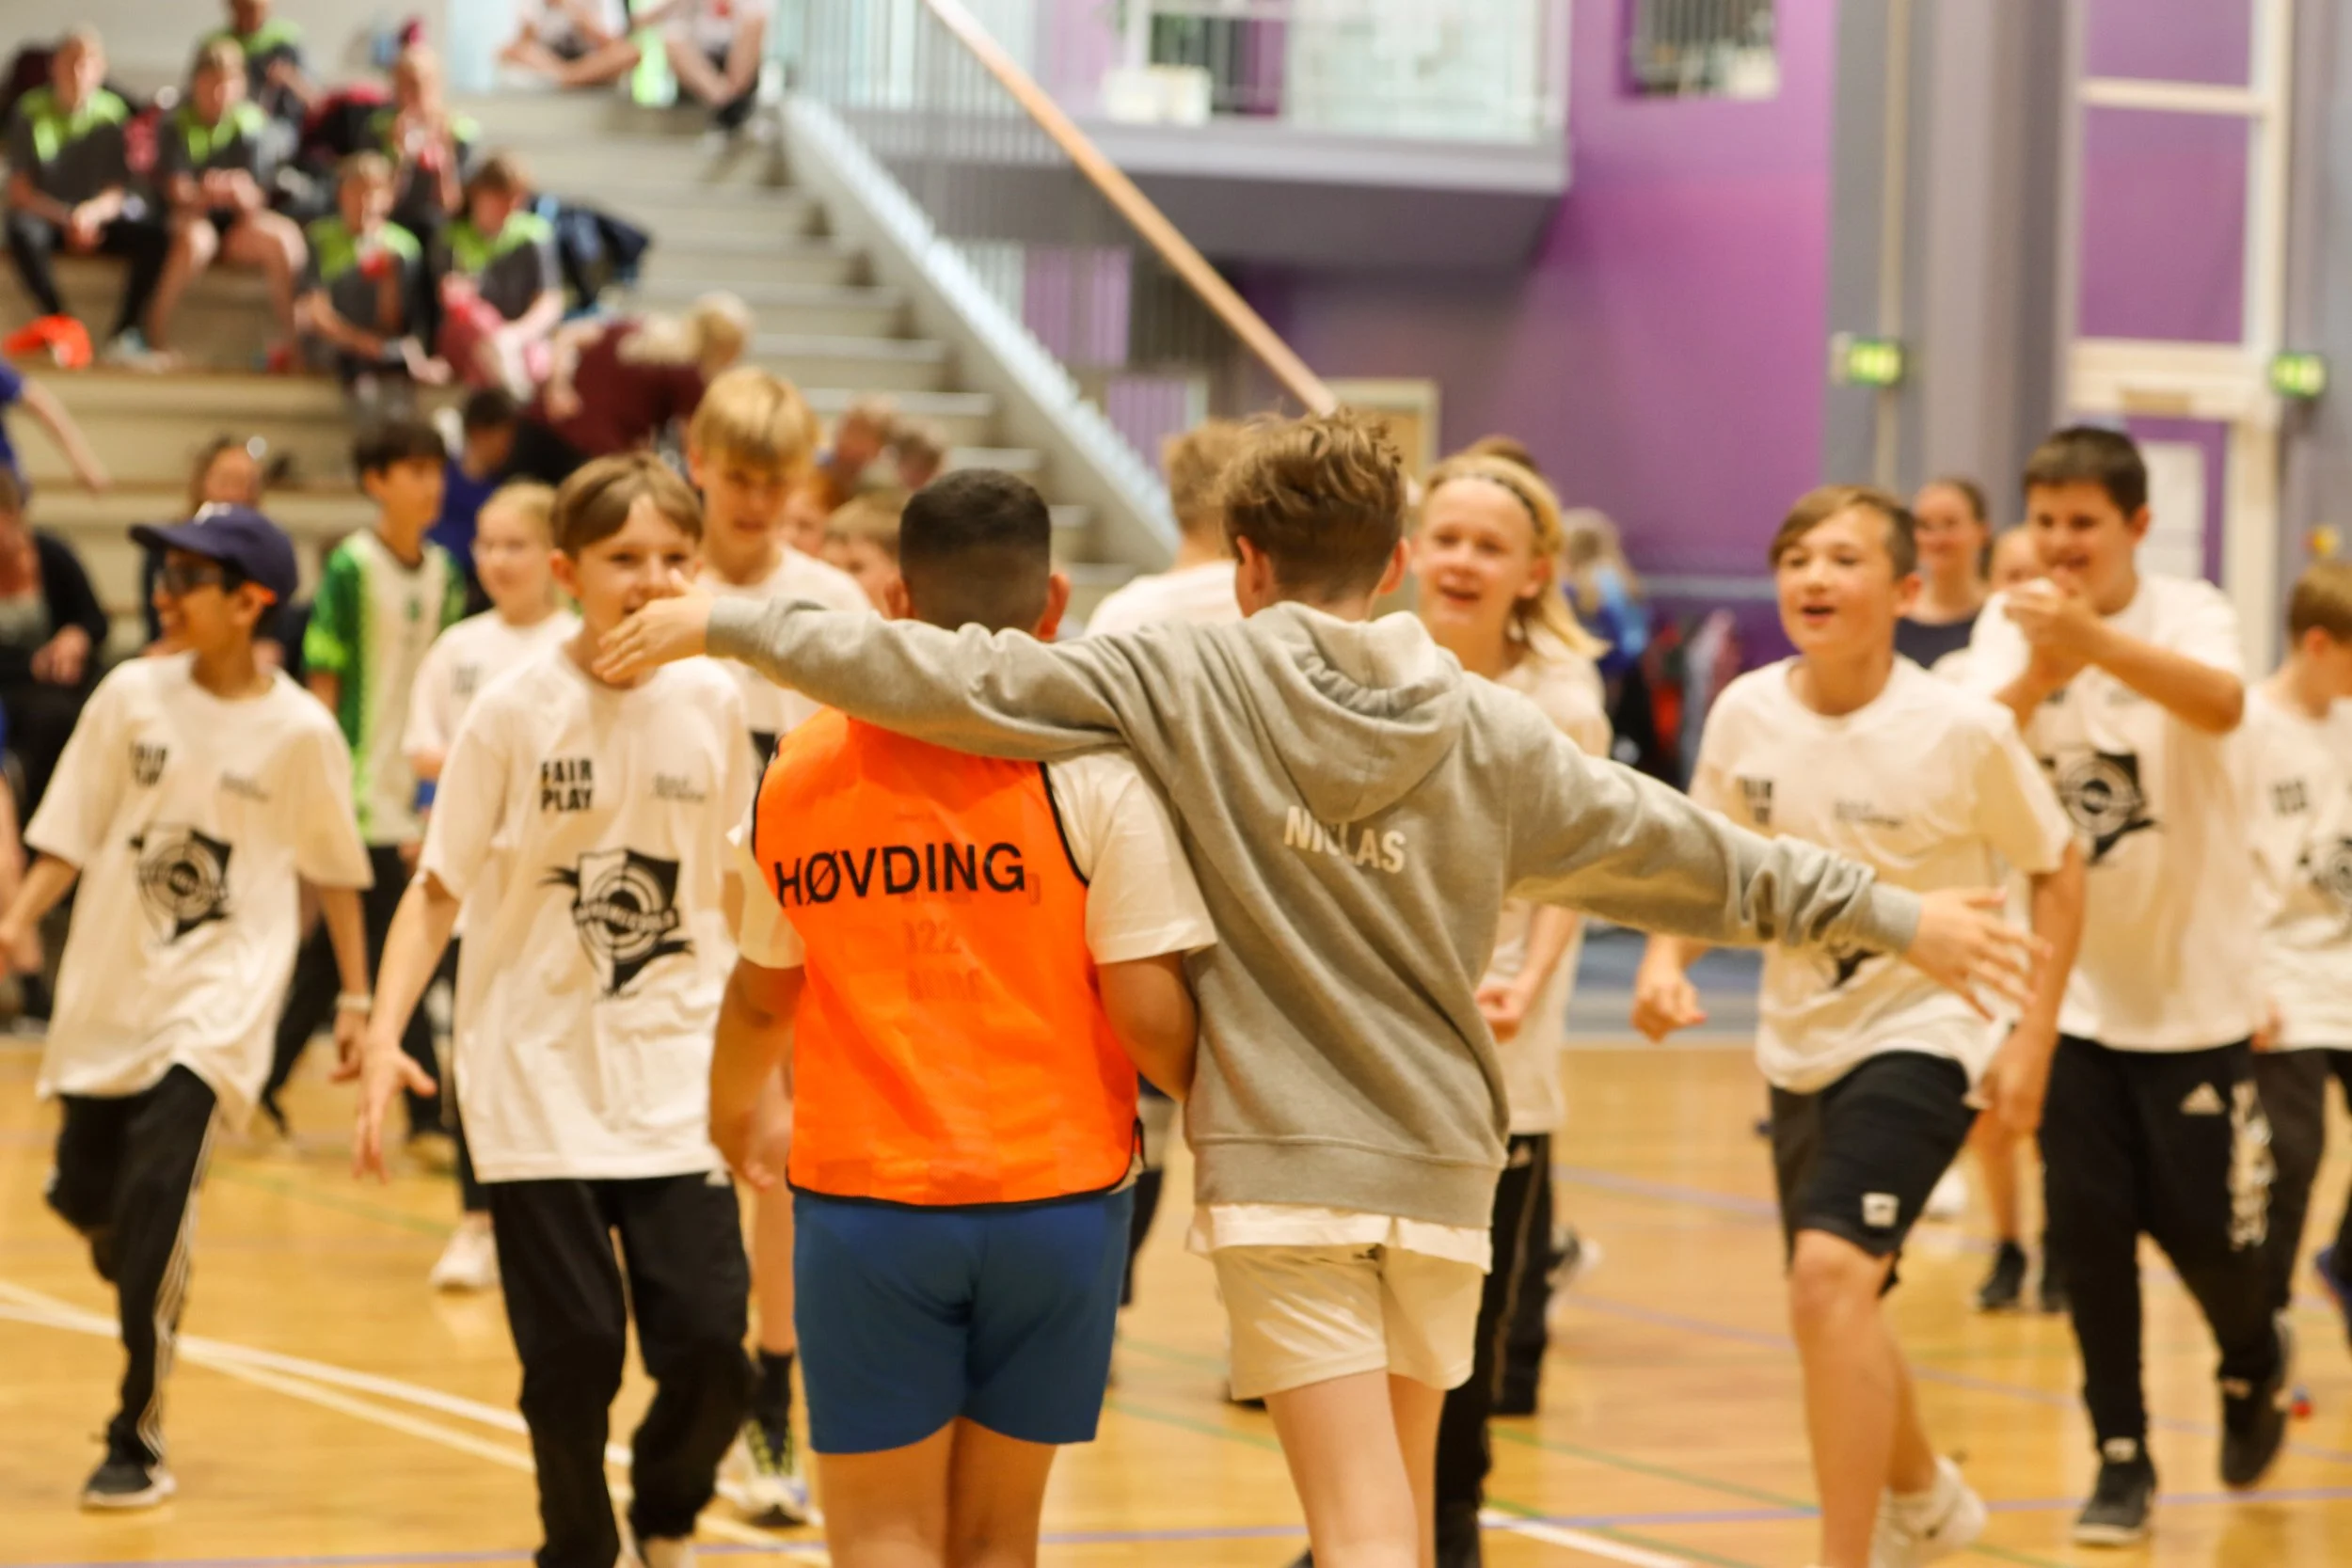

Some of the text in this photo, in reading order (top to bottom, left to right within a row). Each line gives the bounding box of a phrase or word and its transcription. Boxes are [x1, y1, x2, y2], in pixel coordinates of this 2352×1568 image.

[541, 758, 593, 783] FAIR
[540, 788, 593, 811] PLAY
[773, 842, 1025, 908] HØVDING
